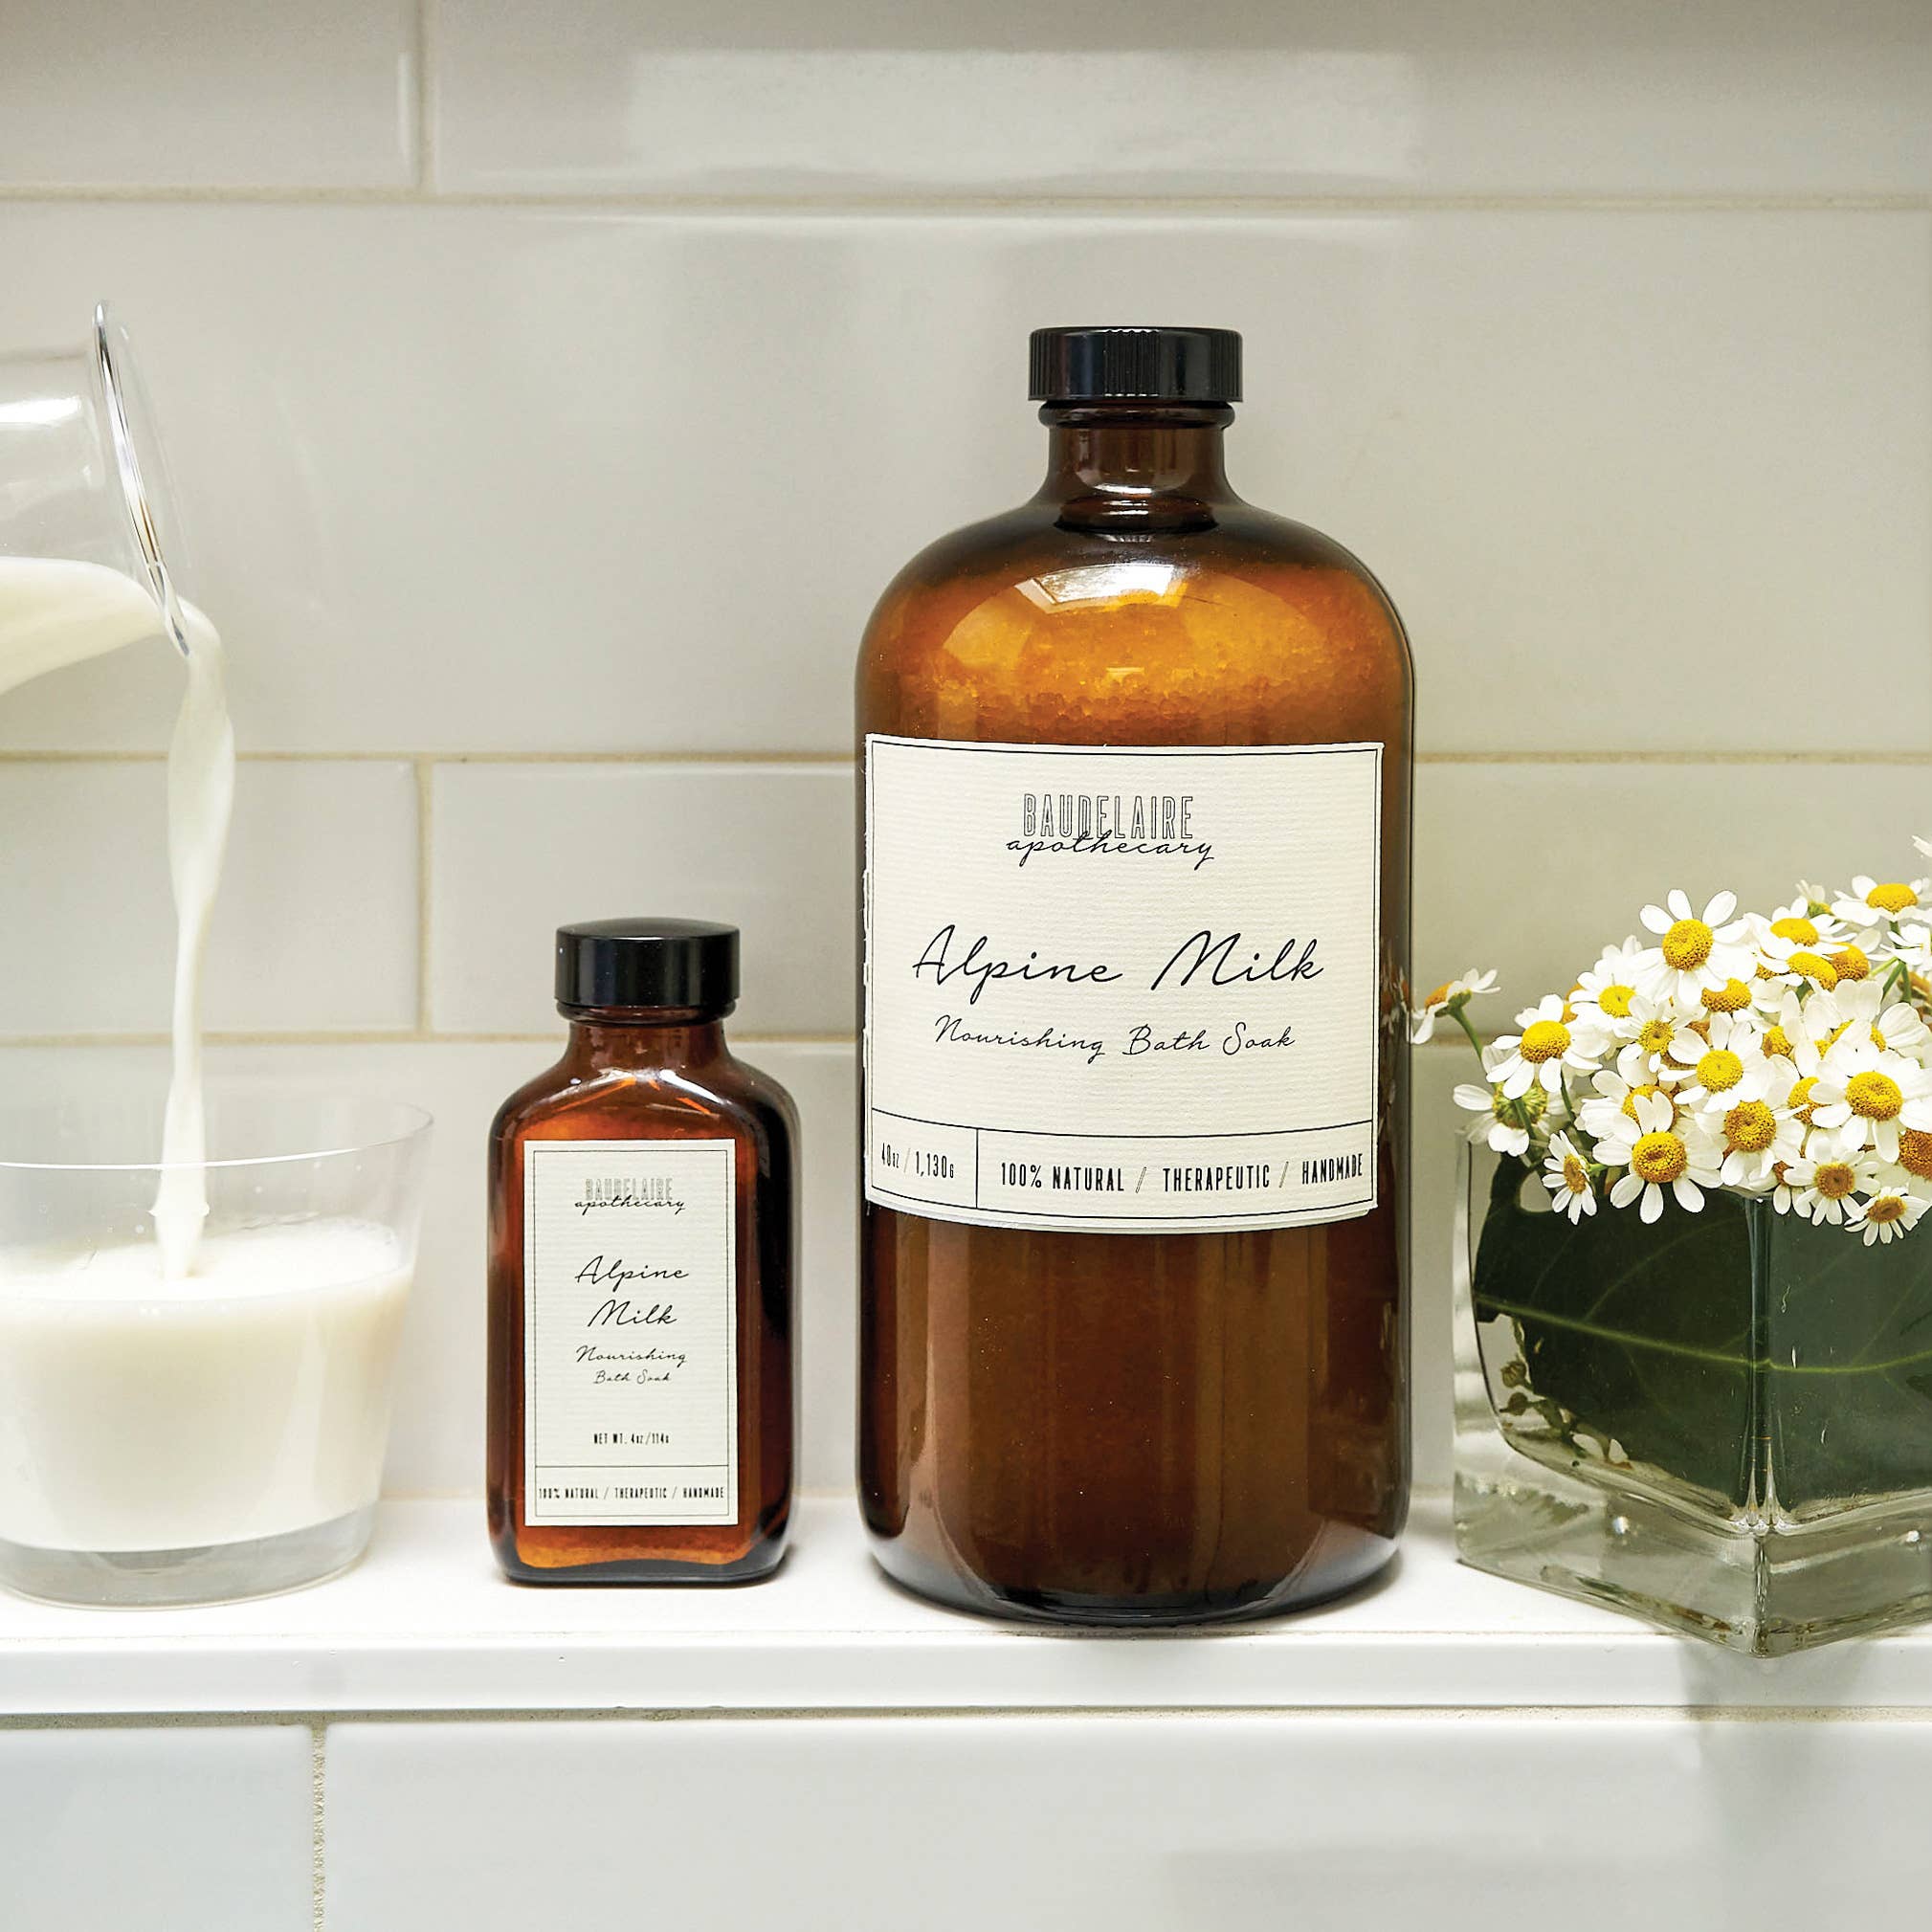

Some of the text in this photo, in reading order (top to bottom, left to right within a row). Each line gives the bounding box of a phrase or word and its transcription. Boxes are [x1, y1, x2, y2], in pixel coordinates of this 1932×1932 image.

[1023, 793, 1193, 839] BAUDELAIRE
[1007, 830, 1214, 870] apothecary
[912, 924, 1324, 1005] Alpine Milk
[935, 1015, 1295, 1064] Nourishing Bath Soak
[1002, 1163, 1041, 1188] 100%
[1053, 1166, 1124, 1191] NATURAL
[1163, 1165, 1269, 1191] THERAPEUTIC
[1302, 1153, 1363, 1184] HANDMADE
[585, 1178, 673, 1200] BAUDELAIRE
[575, 1195, 684, 1215] apothecary
[575, 1255, 689, 1292] Alpine
[588, 1299, 677, 1326] Milk
[576, 1345, 687, 1368] Nourishing
[593, 1369, 670, 1384] Bath Soak
[593, 1432, 608, 1444] NET
[540, 1488, 560, 1499] 100%
[566, 1488, 598, 1499] NATURAL
[615, 1488, 666, 1499] THERAPEUTIC
[683, 1487, 723, 1498] HANDMADE
